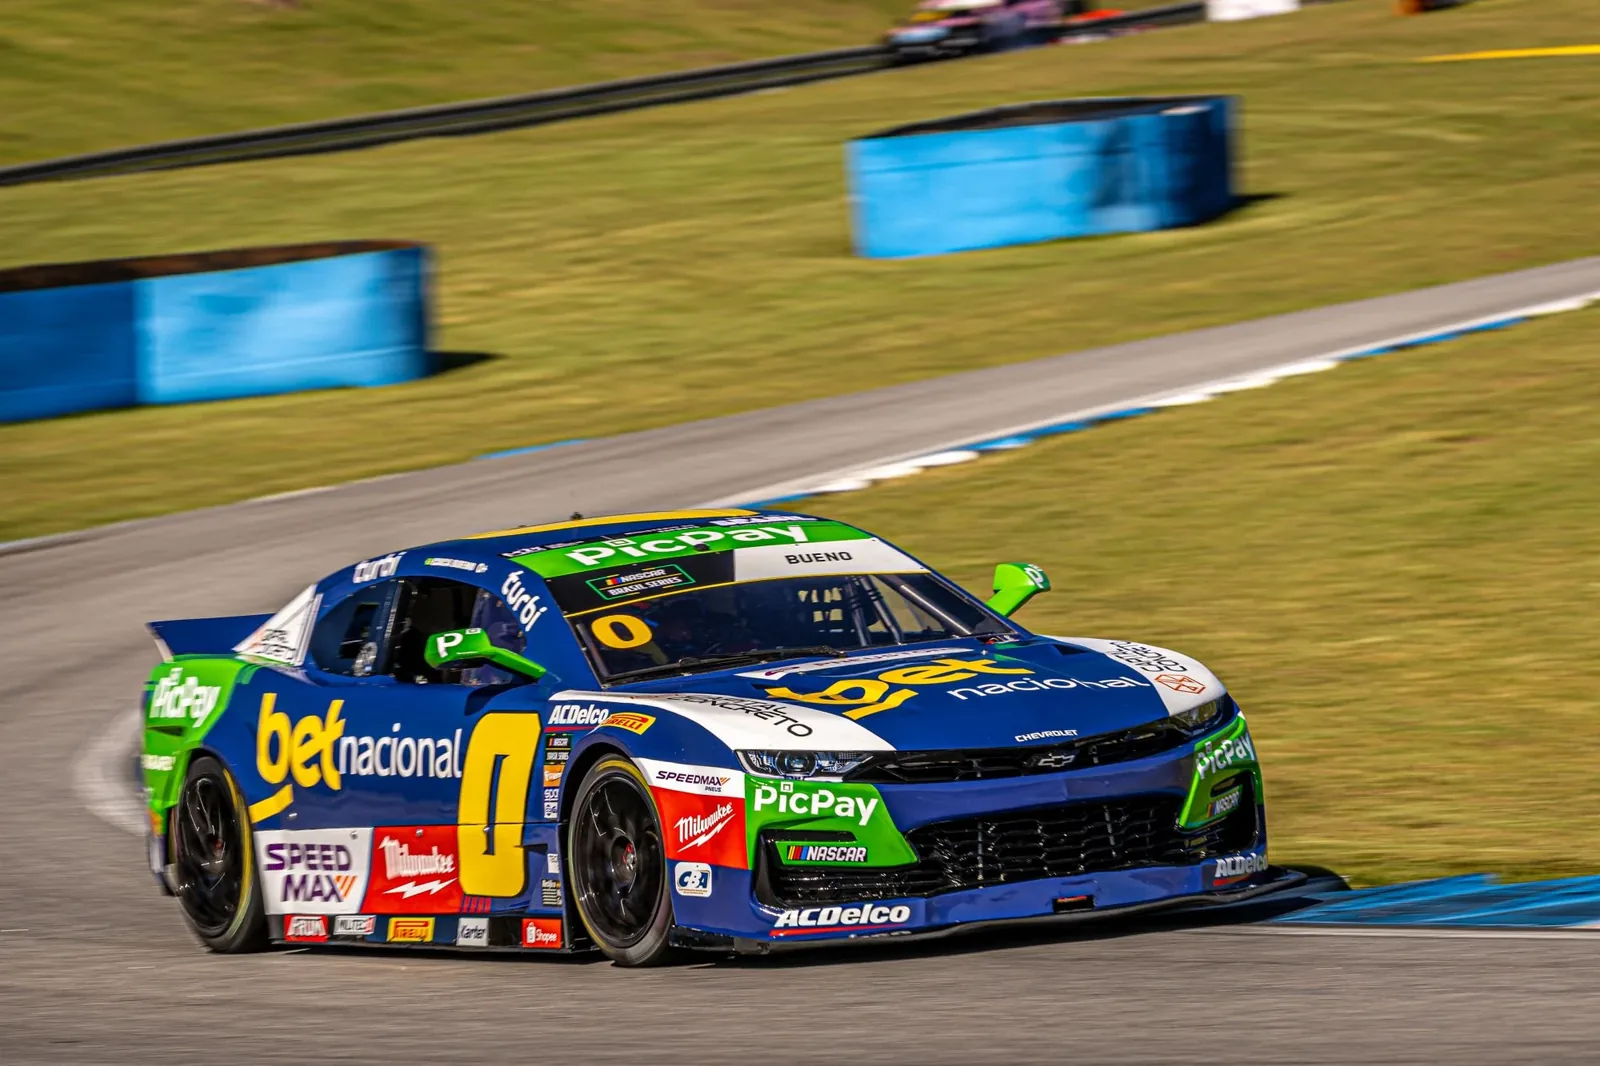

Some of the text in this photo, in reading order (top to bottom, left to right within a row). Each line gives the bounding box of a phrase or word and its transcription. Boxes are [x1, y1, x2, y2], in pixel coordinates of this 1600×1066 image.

[565, 525, 809, 566] PicPay
[785, 550, 853, 565] BUENO
[607, 576, 683, 597] BRASIL SERIES
[621, 568, 667, 584] NASCAR
[501, 570, 548, 632] turbi
[591, 614, 653, 649] 0
[764, 657, 1035, 706] bet
[948, 675, 1150, 702] nacional
[548, 704, 609, 725] ACDelco
[256, 692, 463, 790] bet nacional
[1015, 729, 1079, 742] CHEVROLET
[1195, 733, 1256, 780] PicPay
[655, 770, 729, 787] SPEEDMAX
[457, 712, 540, 898] 0
[753, 781, 879, 826] PicPay
[674, 802, 734, 843] Milwaukee
[264, 843, 353, 871] SPEED
[806, 846, 867, 862] NASCAR
[1215, 852, 1269, 878] ACDelco
[279, 874, 345, 903] MAX
[678, 870, 709, 889] CBA
[773, 903, 911, 928] ACDelco
[535, 929, 557, 944] Shopee
